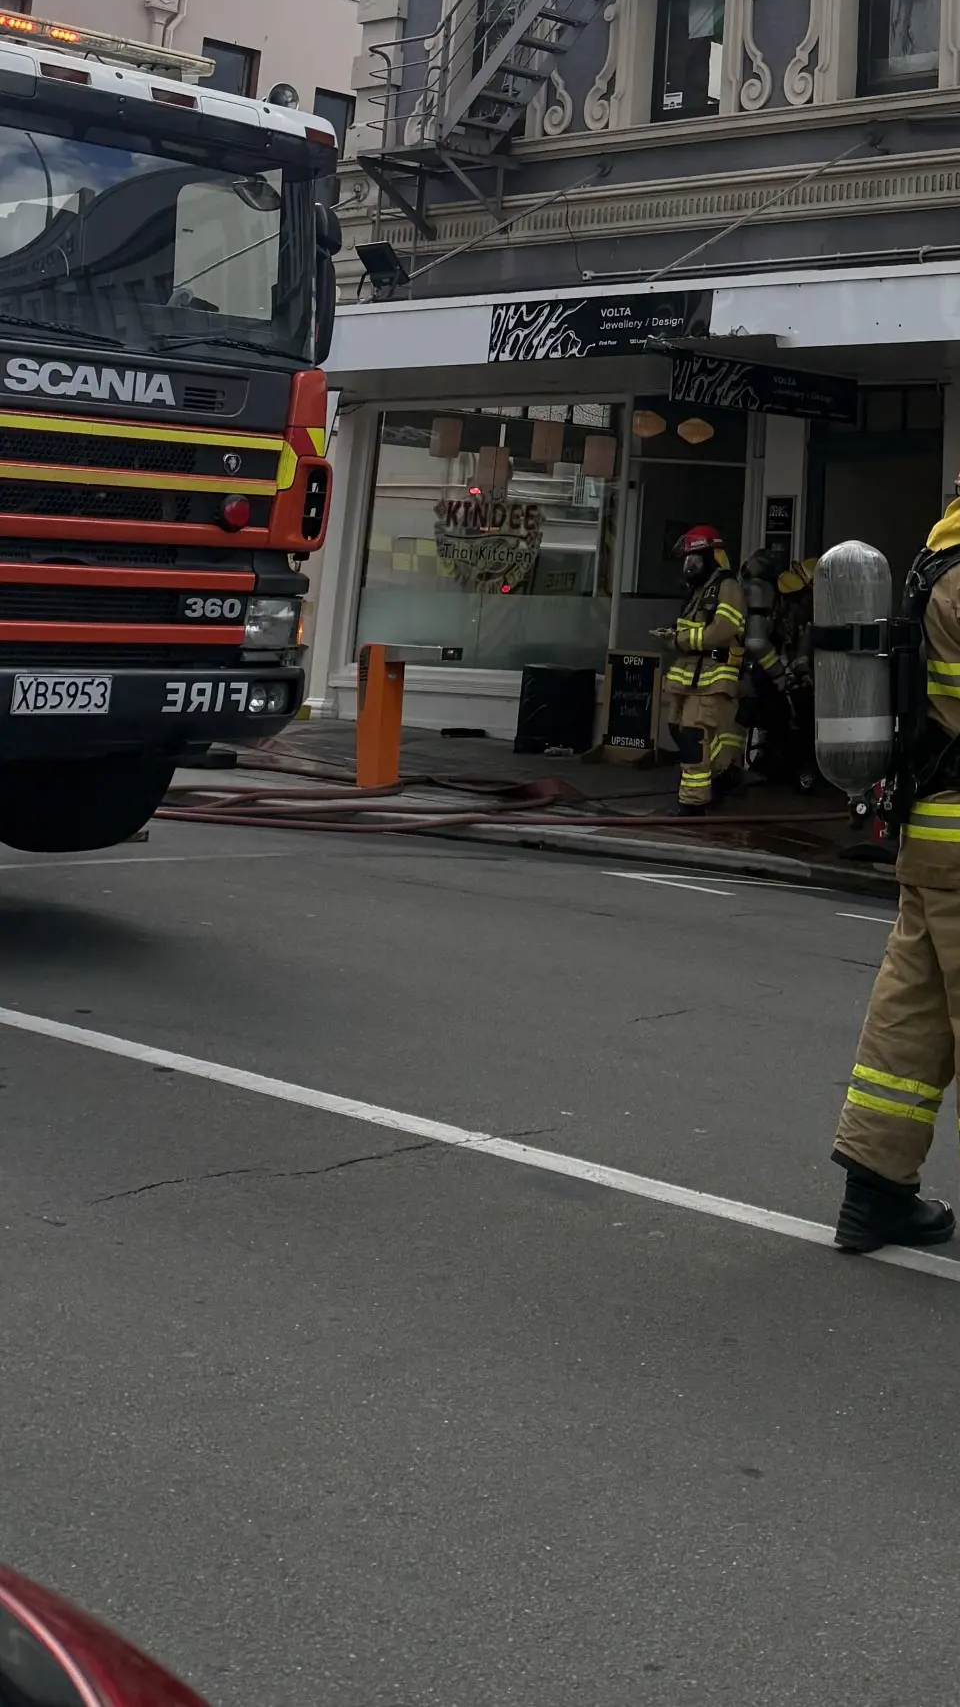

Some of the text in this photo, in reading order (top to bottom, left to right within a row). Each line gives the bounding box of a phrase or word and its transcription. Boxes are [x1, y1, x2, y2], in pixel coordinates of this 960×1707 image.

[600, 307, 632, 318] VOLTA
[599, 319, 643, 330] Jewellery
[651, 316, 684, 327] Design
[4, 357, 176, 406] SCANIA
[445, 500, 540, 530] KINDEE
[443, 543, 532, 563] Thai Kitchen
[184, 598, 242, 619] 360
[623, 655, 644, 666] OPEN
[16, 680, 109, 710] XB5953
[611, 735, 645, 748] UPSTAIRS
